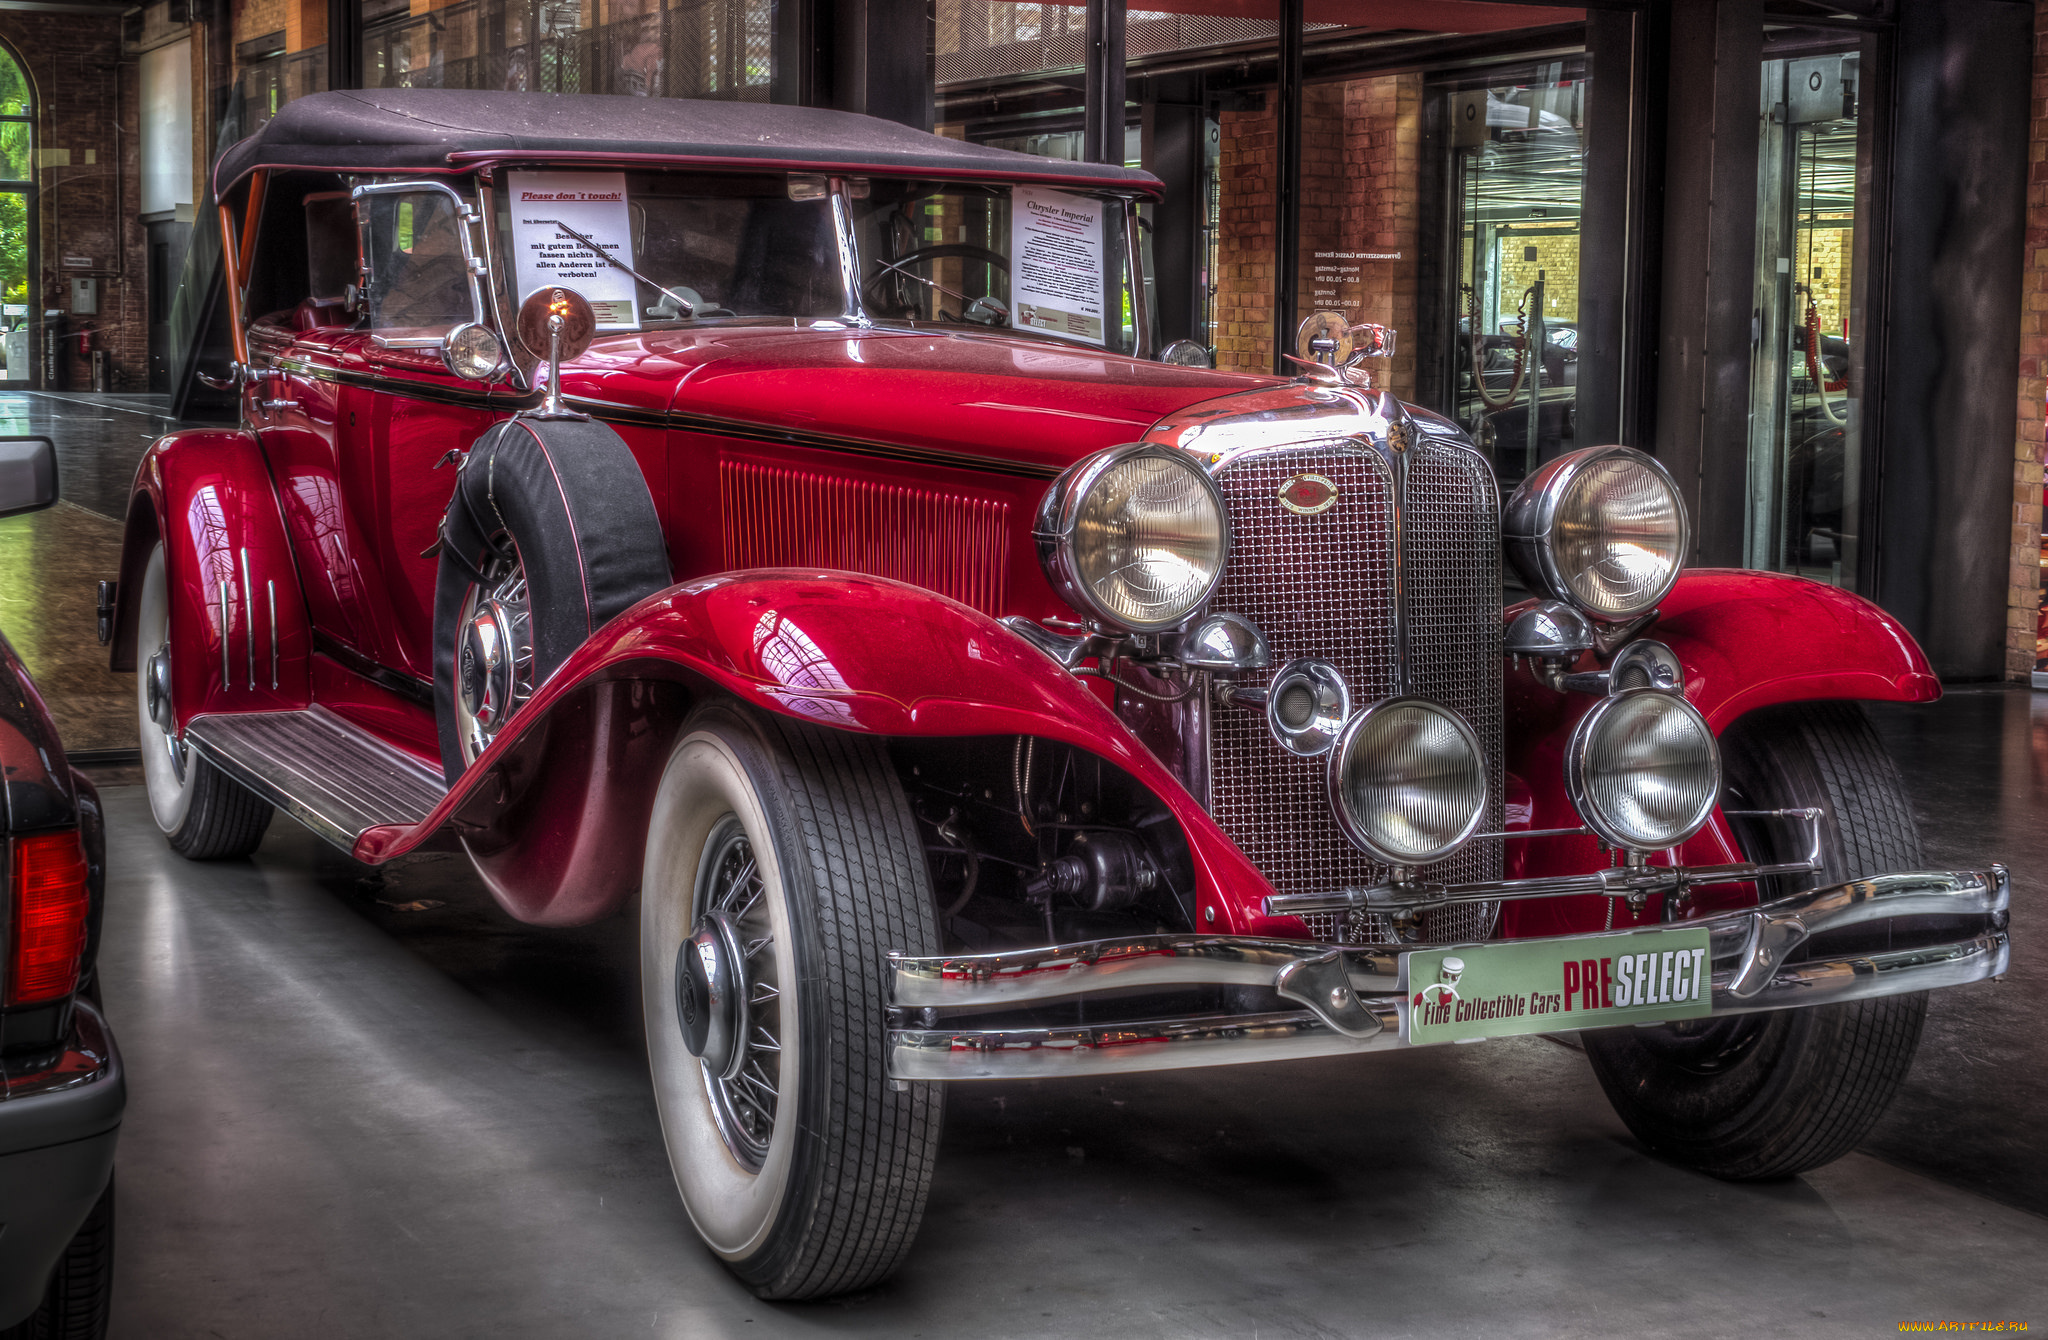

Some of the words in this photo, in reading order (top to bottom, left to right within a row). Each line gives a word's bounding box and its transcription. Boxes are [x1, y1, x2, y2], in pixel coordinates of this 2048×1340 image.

[521, 191, 554, 200] Please
[588, 191, 622, 200] touch!
[1027, 200, 1059, 215] Chrysler
[1061, 208, 1094, 224] Imperial
[555, 232, 593, 240] Besuher
[547, 243, 574, 251] gutem
[558, 261, 593, 269] Anderen
[595, 261, 606, 269] ist
[1423, 1001, 1451, 1026] Fine
[1455, 994, 1525, 1022] Collectible
[1530, 991, 1561, 1015] Cars
